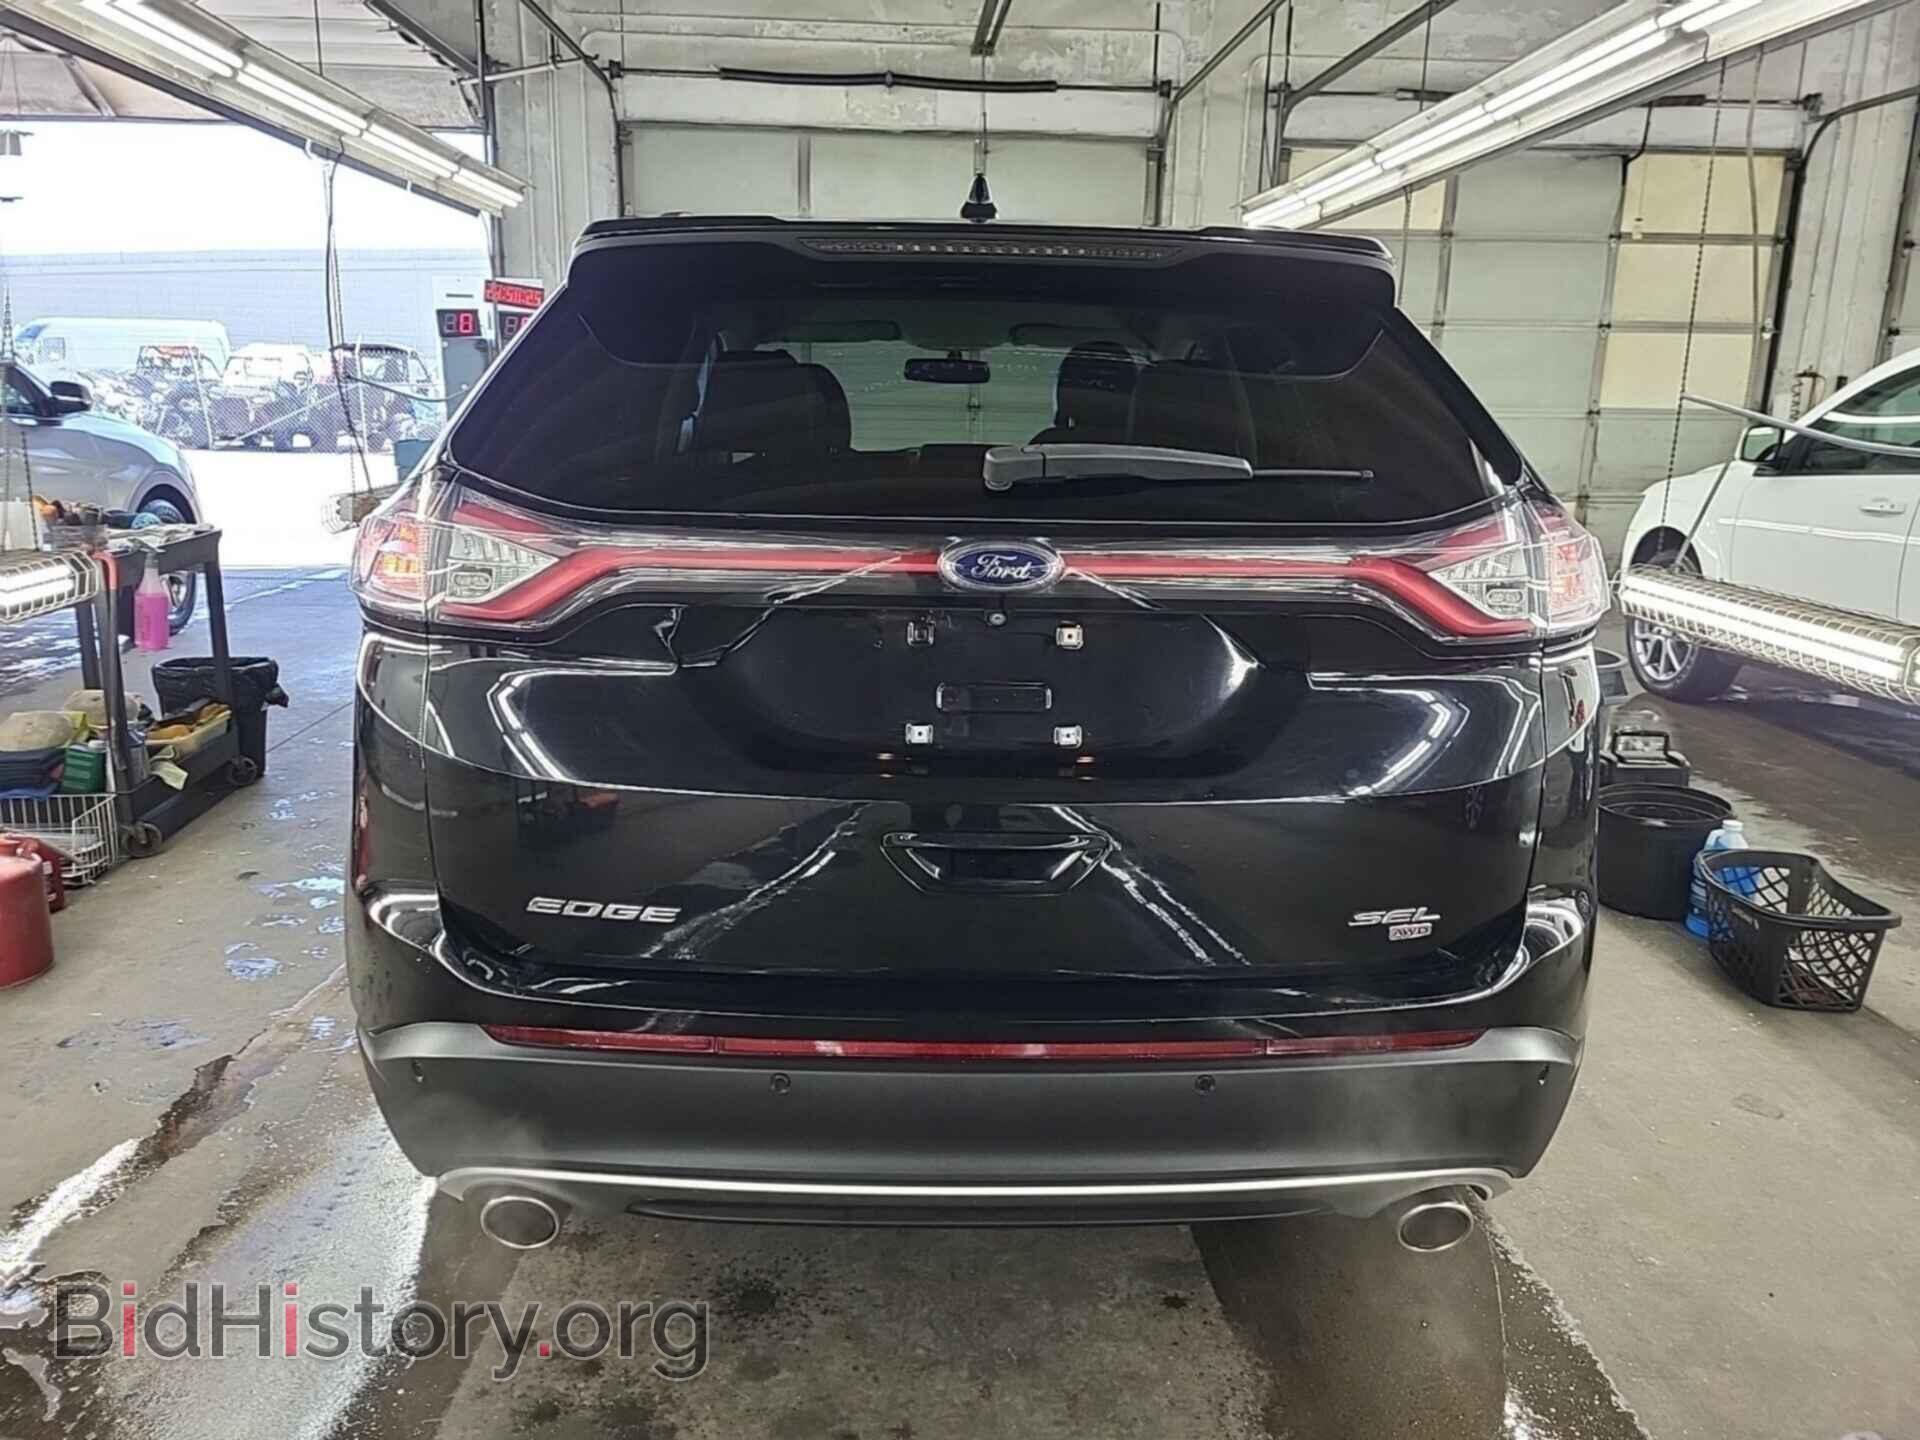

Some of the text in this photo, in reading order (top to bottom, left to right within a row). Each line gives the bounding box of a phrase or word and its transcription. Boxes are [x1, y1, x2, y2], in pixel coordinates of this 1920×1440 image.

[971, 553, 1033, 579] Ford
[526, 896, 682, 923] EDGE
[1348, 907, 1441, 926] SEL
[1391, 925, 1431, 938] AWD
